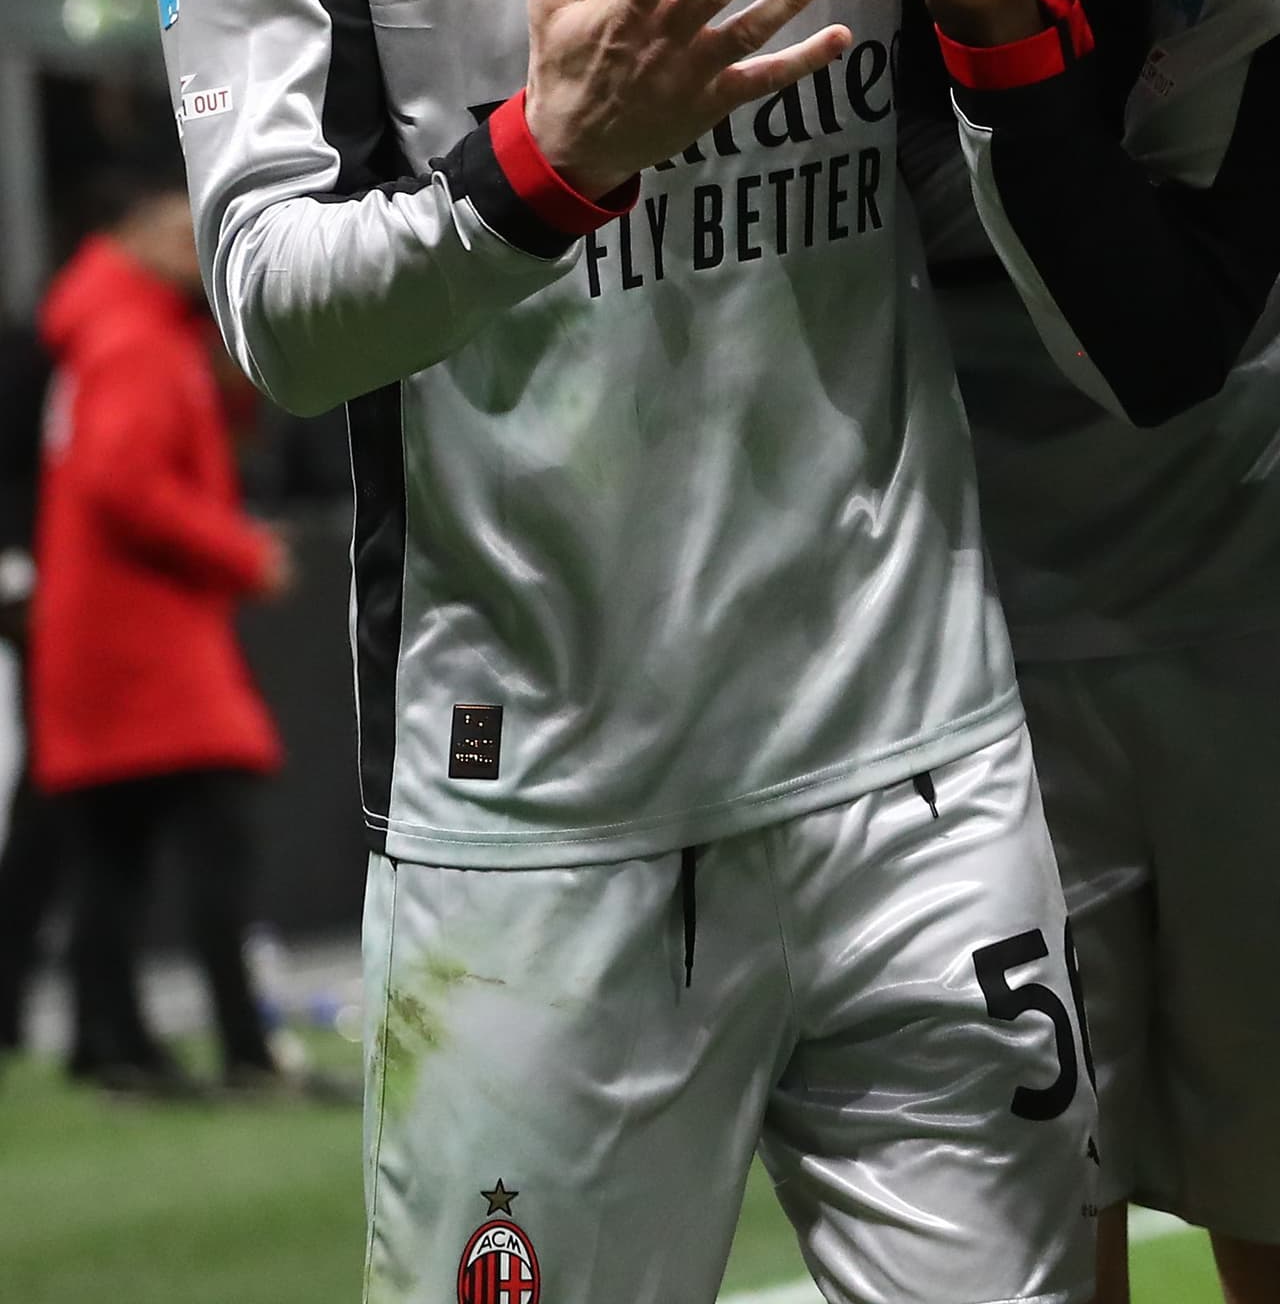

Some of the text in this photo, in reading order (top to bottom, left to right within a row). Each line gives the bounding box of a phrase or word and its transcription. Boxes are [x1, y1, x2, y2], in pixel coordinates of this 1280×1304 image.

[194, 90, 229, 114] OUT
[585, 146, 883, 298] FLY BETTER
[972, 915, 1098, 1121] 5
[476, 1230, 522, 1255] ACM
